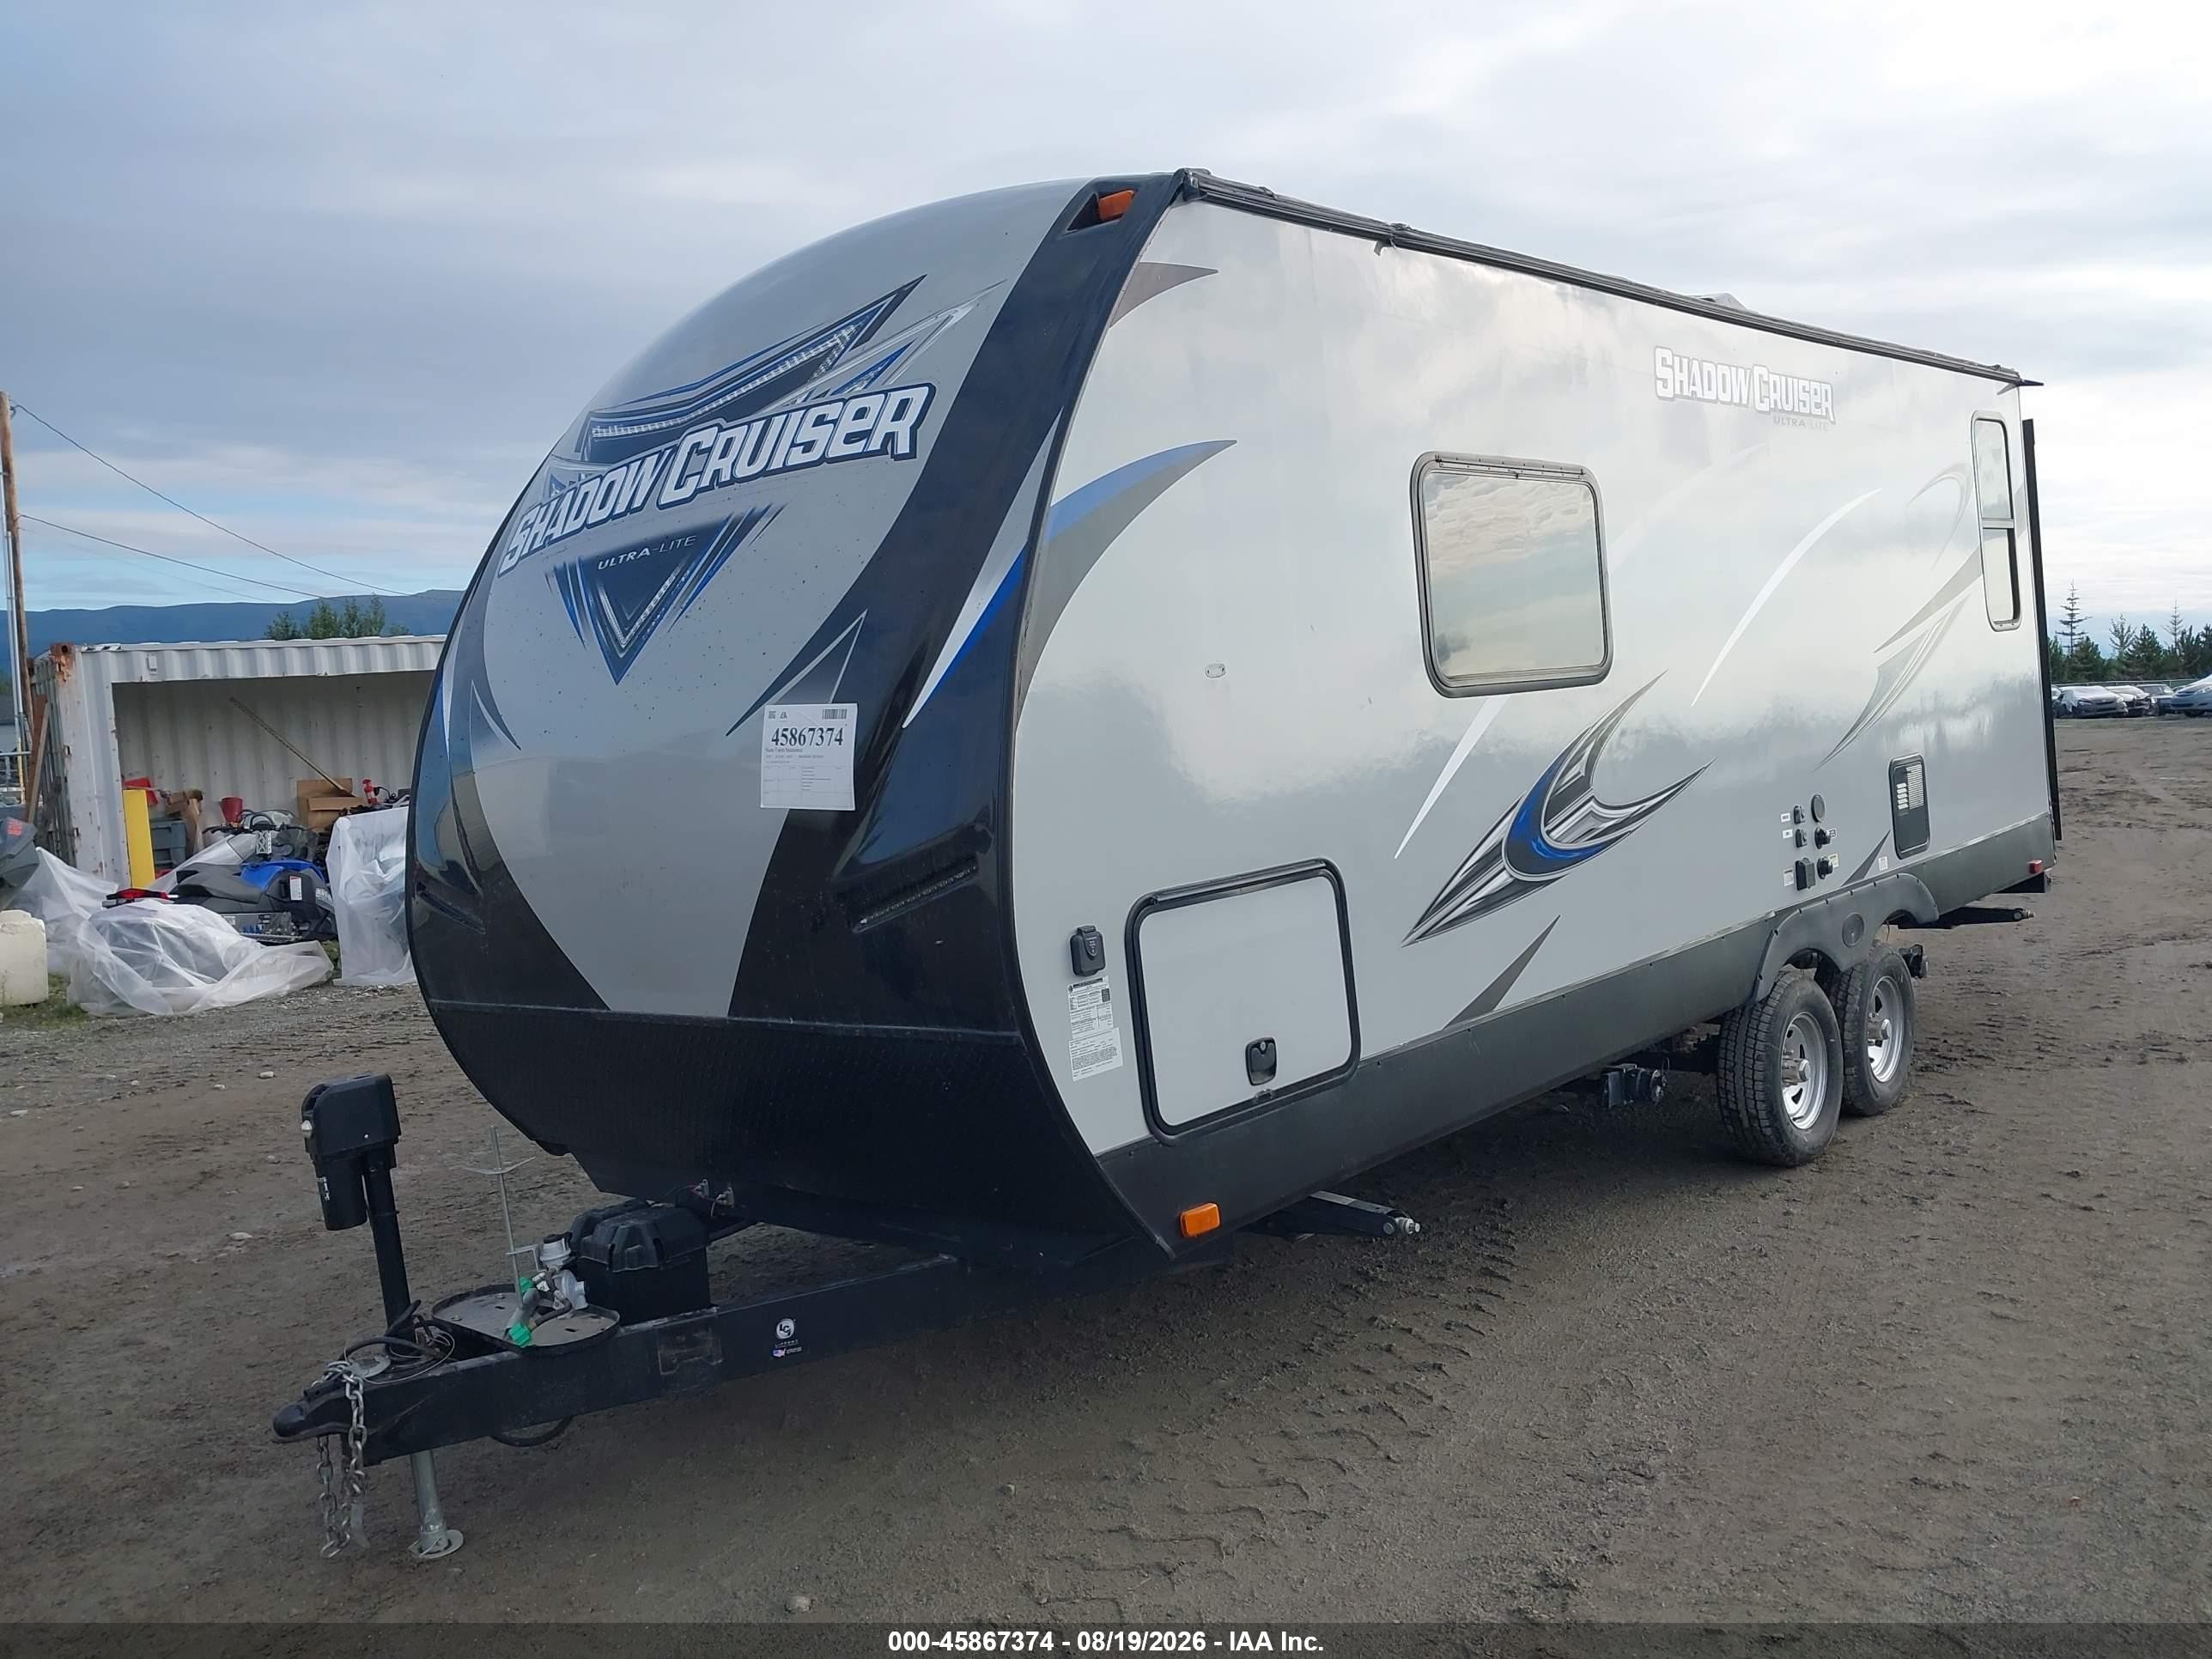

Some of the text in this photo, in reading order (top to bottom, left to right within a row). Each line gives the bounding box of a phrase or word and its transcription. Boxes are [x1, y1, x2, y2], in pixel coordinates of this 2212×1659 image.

[1655, 346, 1835, 422] SHADOW CRUISER
[498, 383, 935, 576] SHADOW CRUISER
[598, 536, 696, 570] ULTRA-LITE
[771, 726, 843, 746] 45867374
